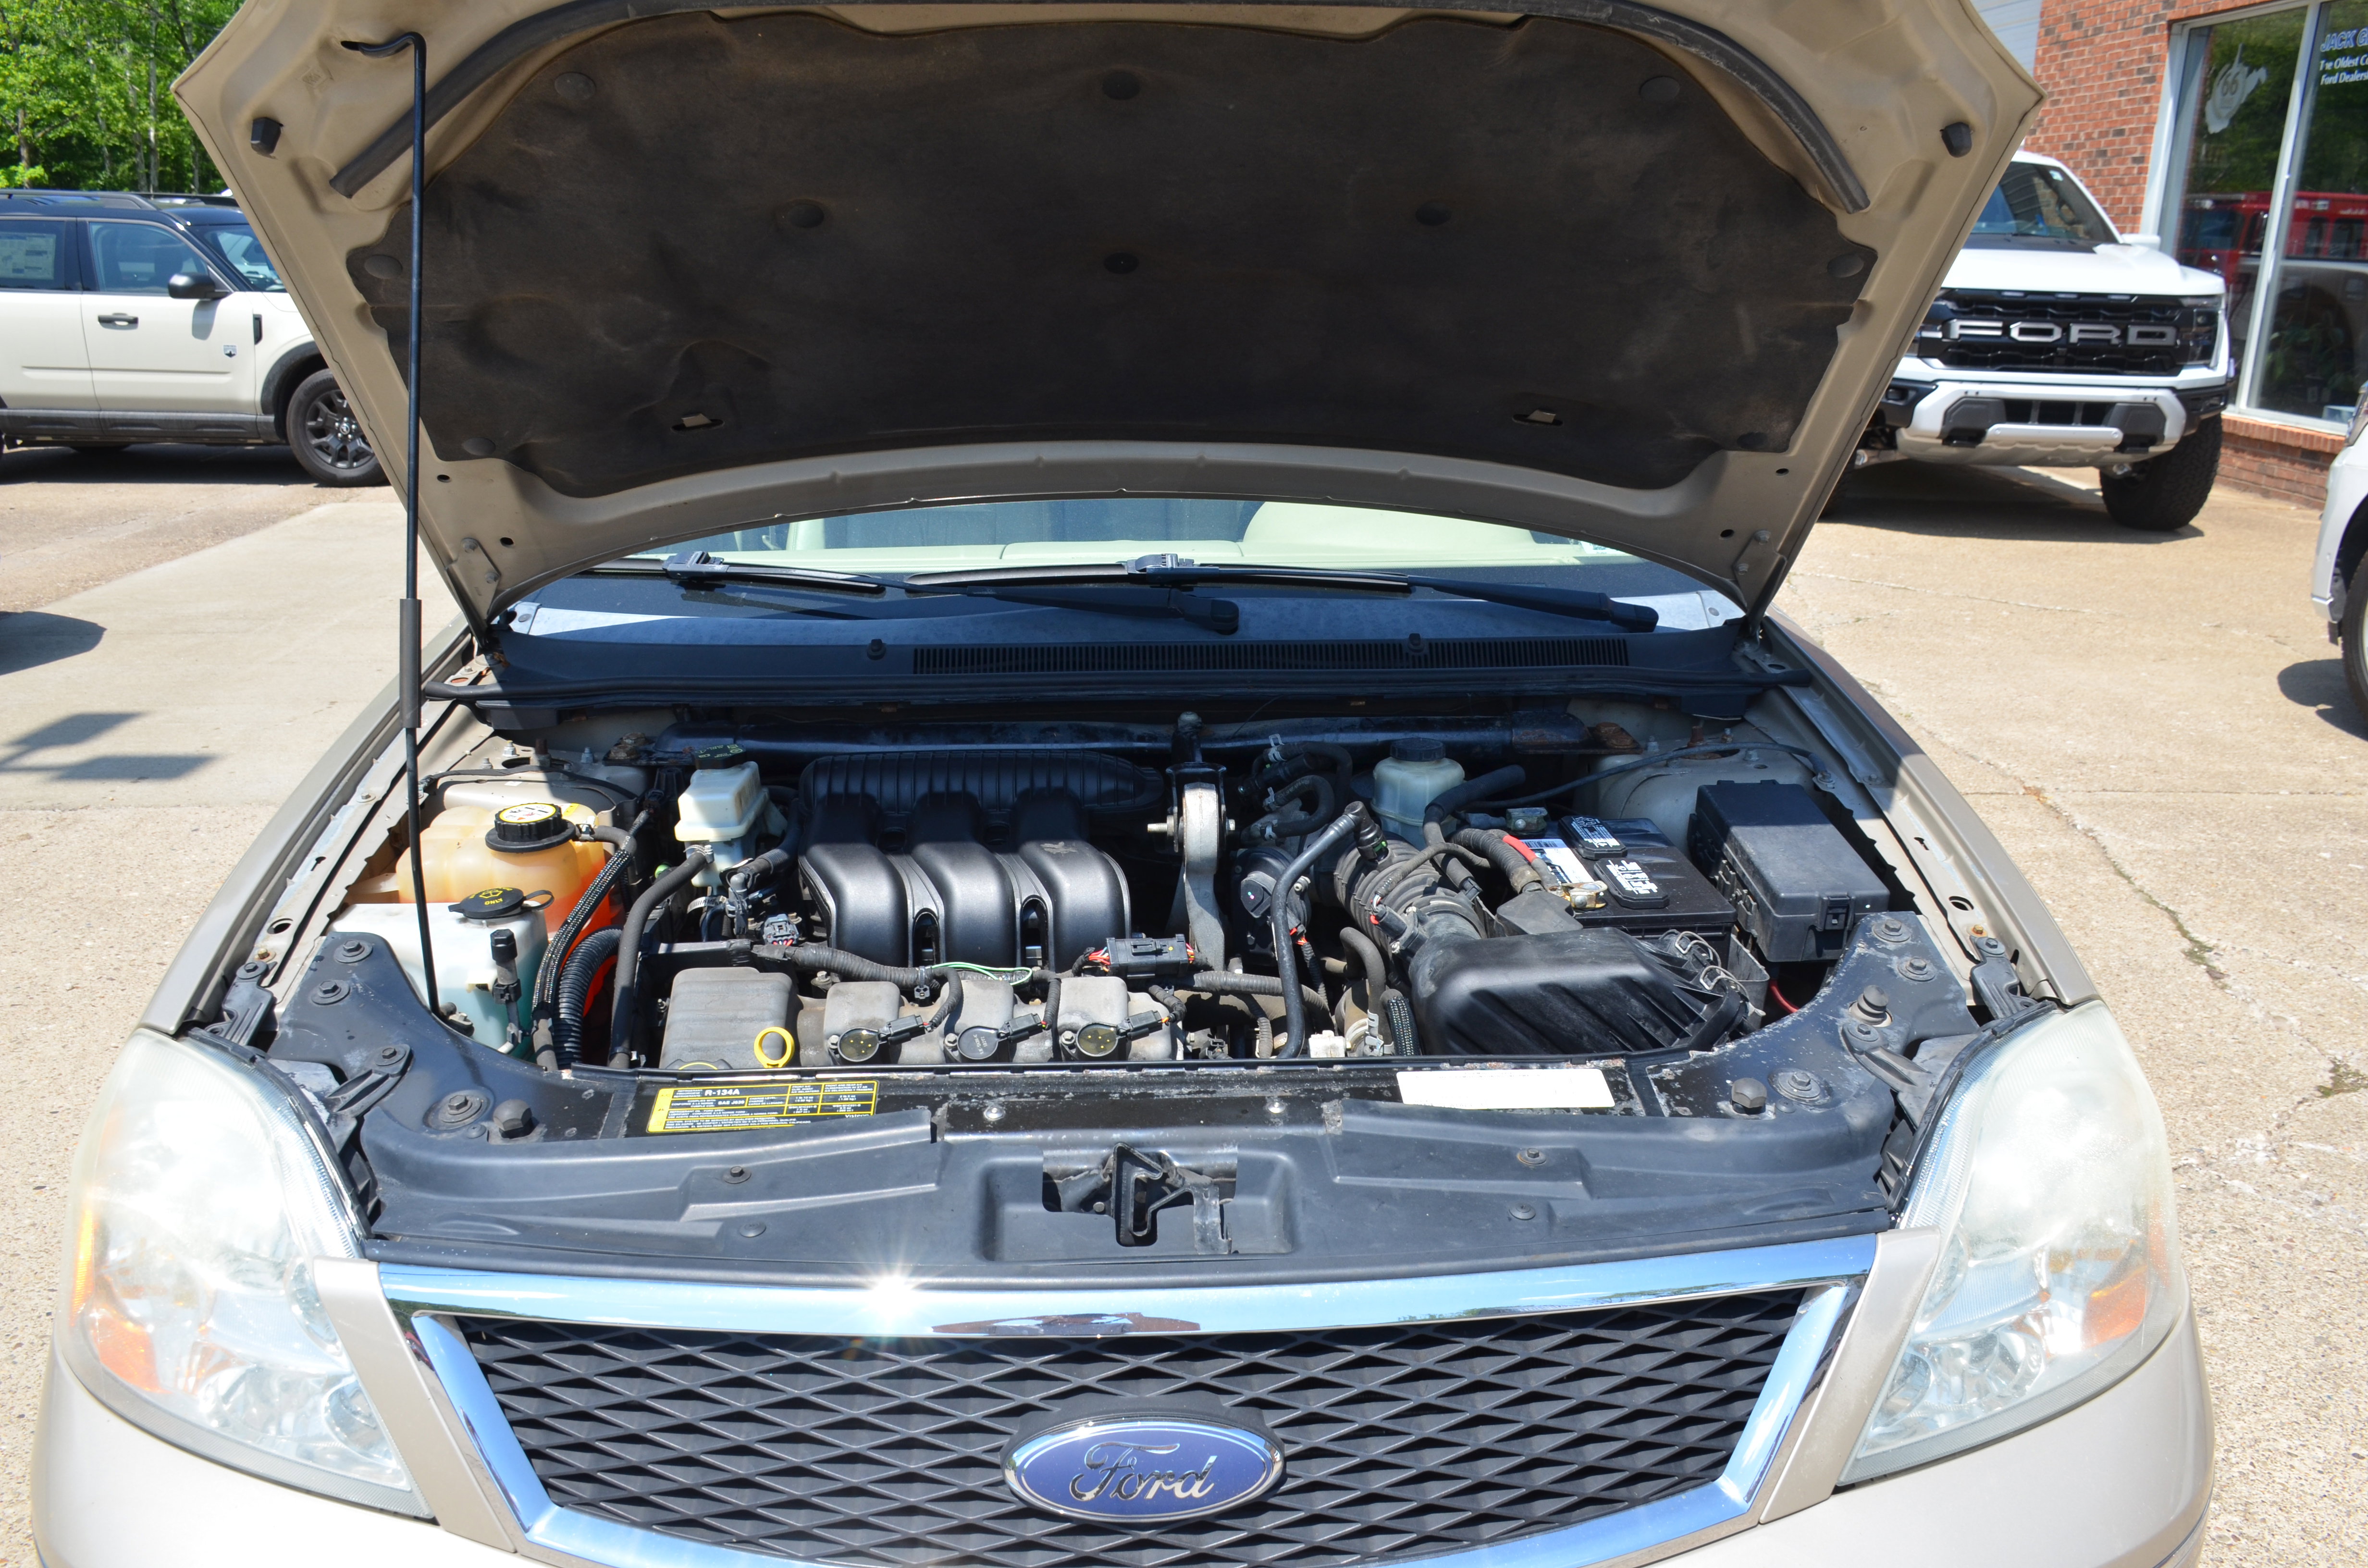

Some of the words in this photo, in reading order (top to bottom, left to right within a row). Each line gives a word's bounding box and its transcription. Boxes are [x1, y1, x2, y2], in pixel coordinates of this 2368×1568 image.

[2320, 30, 2357, 52] JACK
[2334, 56, 2360, 69] Oldest
[2320, 73, 2339, 85] Ford
[1944, 319, 2179, 347] FORD
[1070, 1442, 1218, 1501] Ford
